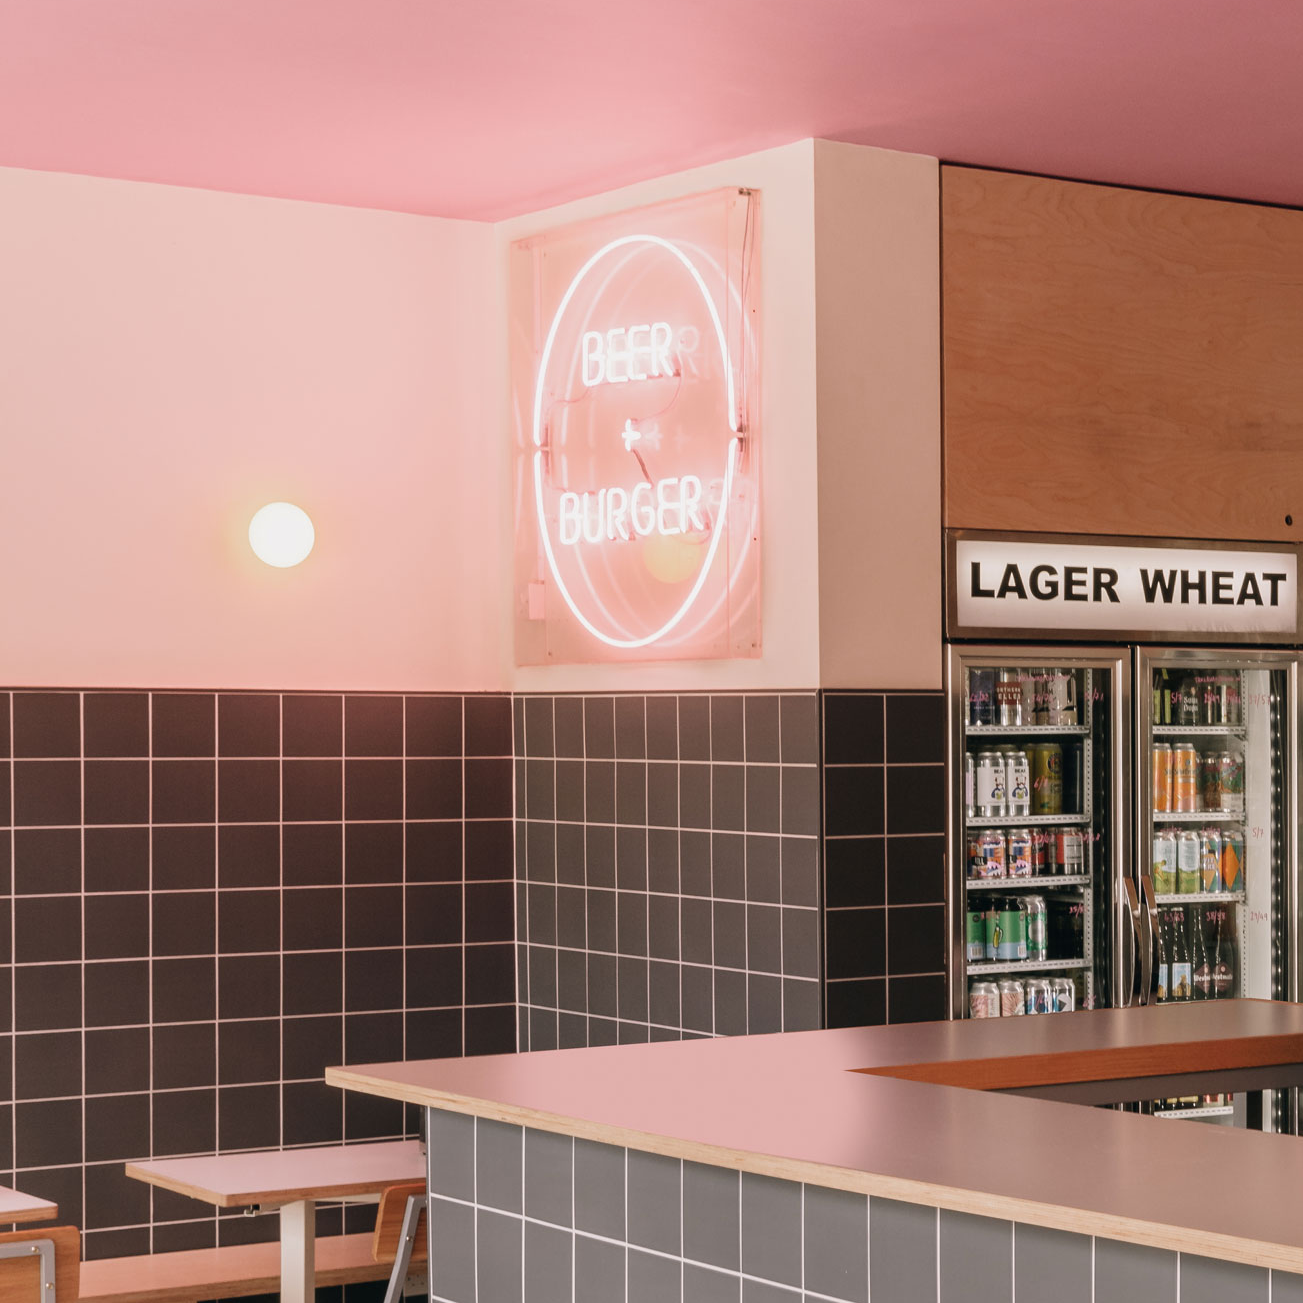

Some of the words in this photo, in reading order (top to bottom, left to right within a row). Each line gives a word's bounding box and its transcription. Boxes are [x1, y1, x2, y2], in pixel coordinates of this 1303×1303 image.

[581, 321, 674, 387] BEER
[559, 474, 706, 545] BURGER
[971, 562, 1121, 603] LAGER
[1139, 569, 1287, 607] WHEAT
